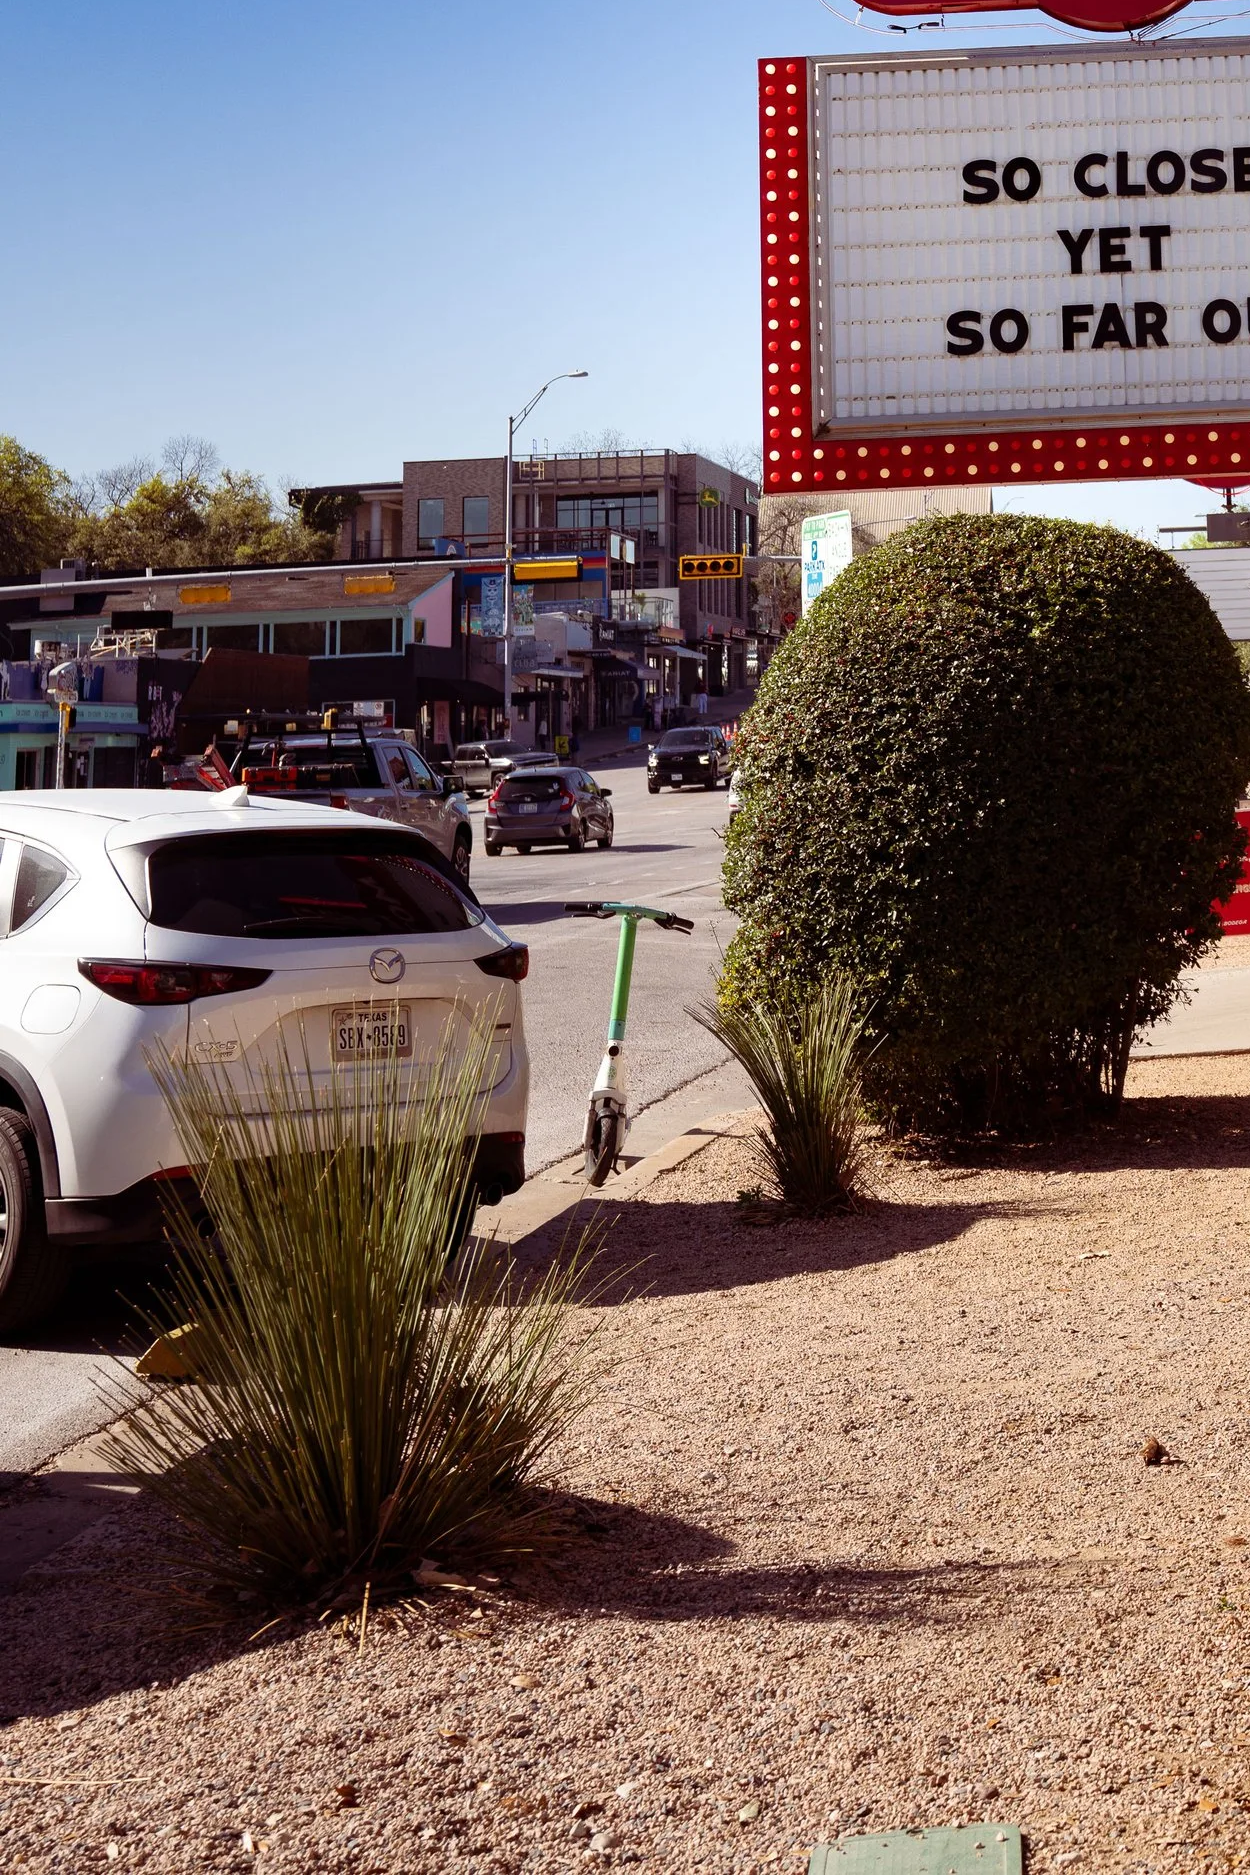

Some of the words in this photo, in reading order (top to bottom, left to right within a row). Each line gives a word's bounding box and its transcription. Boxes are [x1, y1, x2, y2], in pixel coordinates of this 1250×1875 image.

[961, 156, 1042, 205] SO
[1056, 224, 1172, 275] YET
[946, 308, 1030, 359] SO
[1061, 301, 1170, 353] FAR
[358, 1012, 387, 1022] TEXAS
[194, 1040, 238, 1053] CX-5
